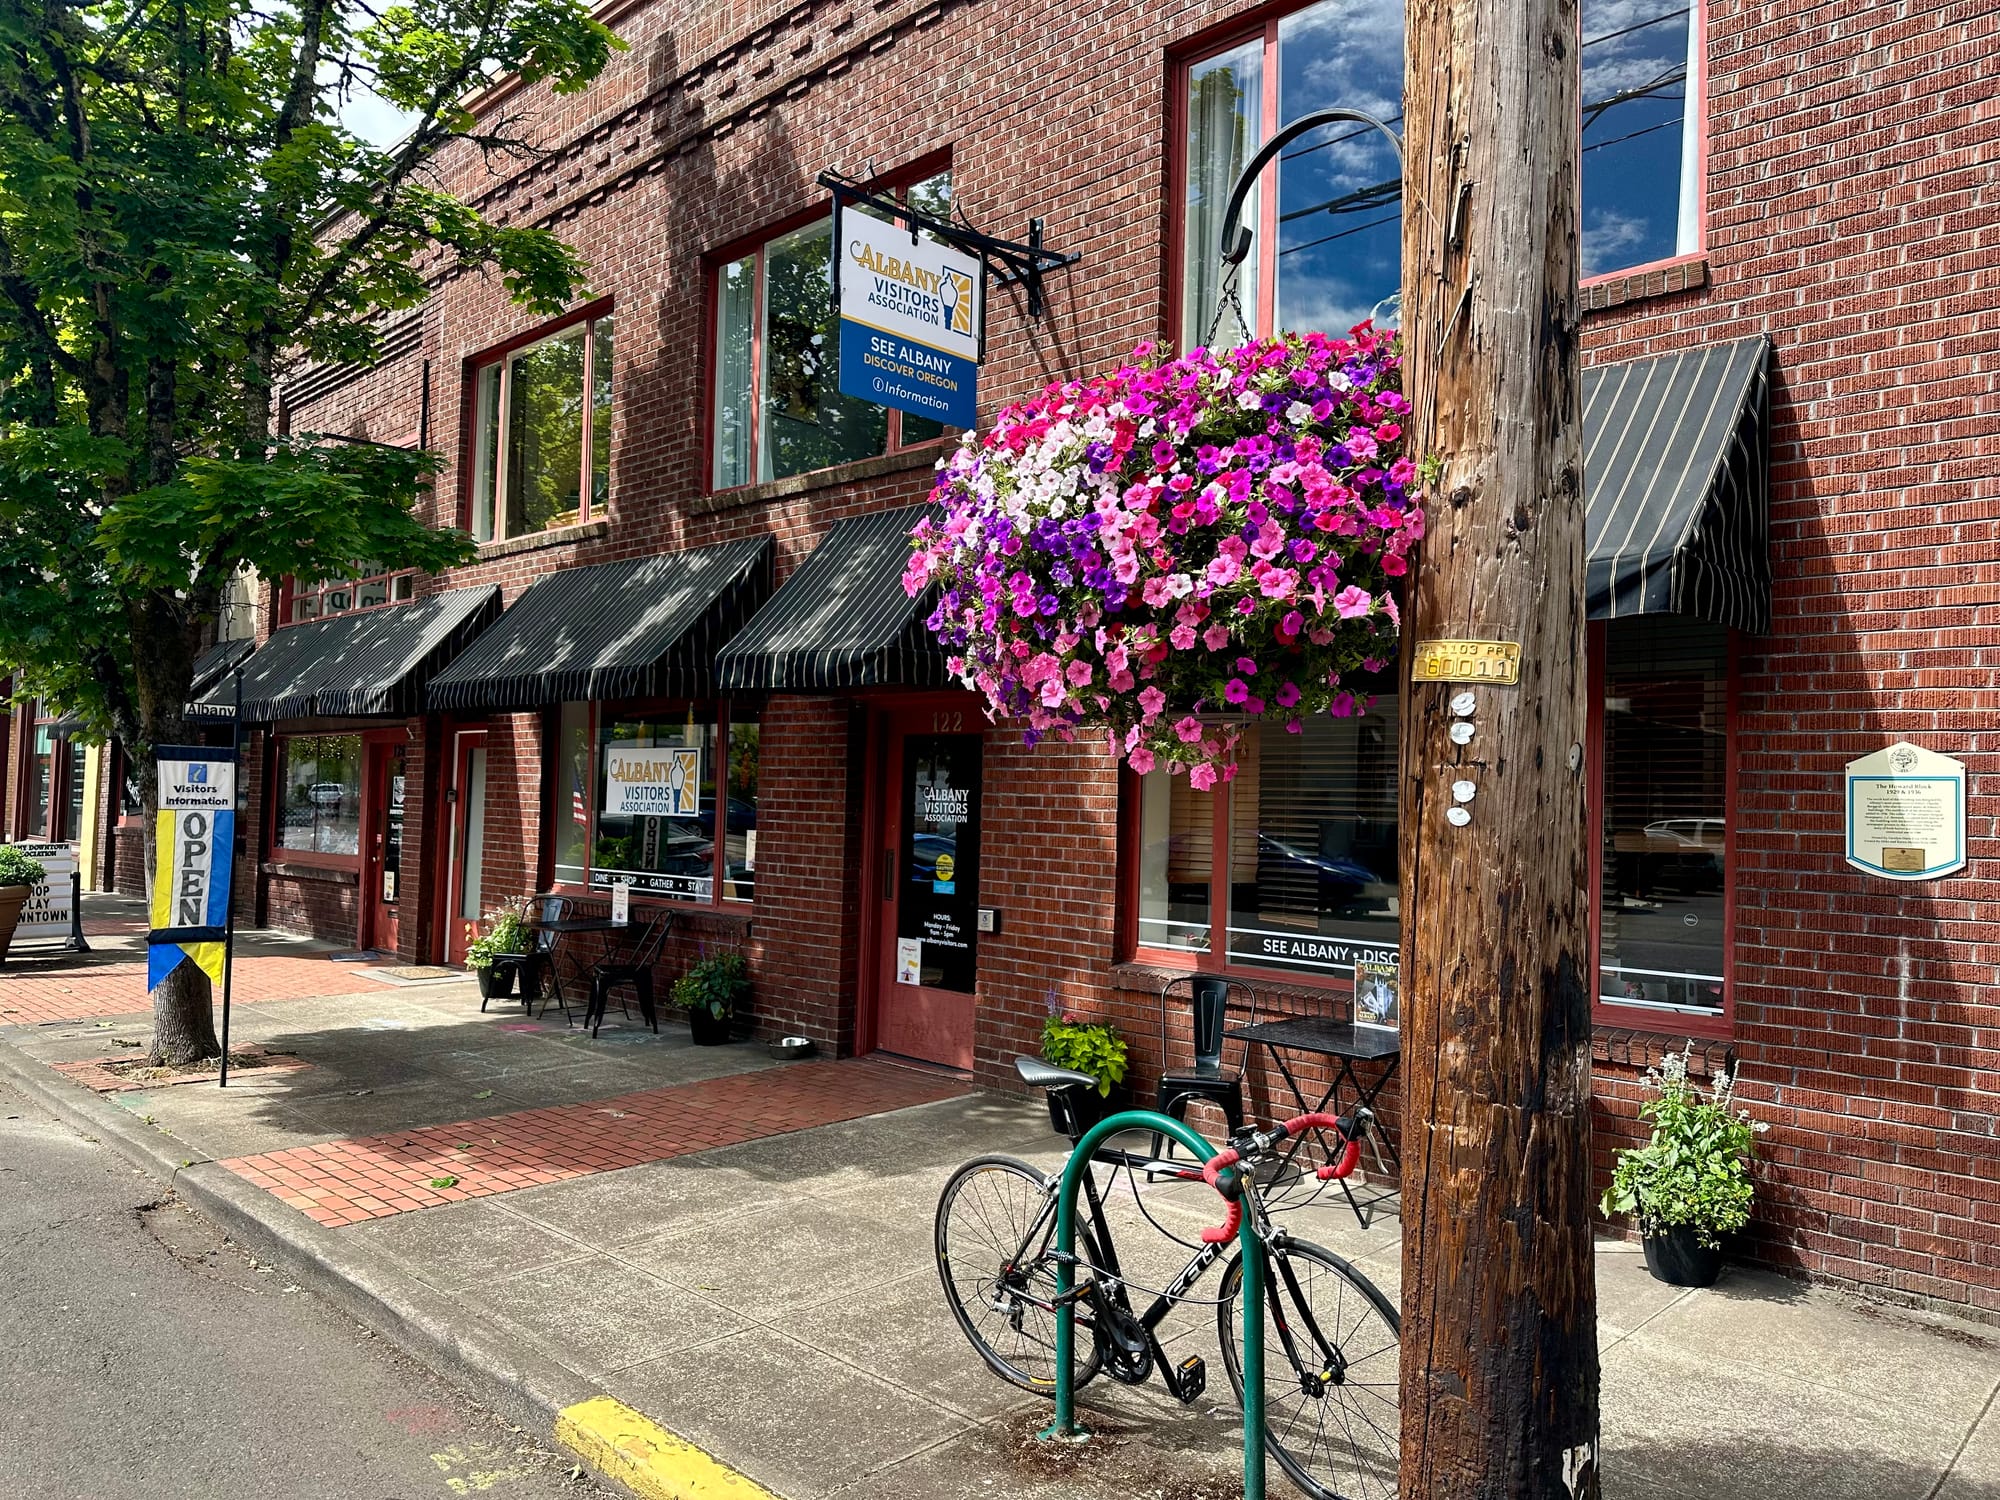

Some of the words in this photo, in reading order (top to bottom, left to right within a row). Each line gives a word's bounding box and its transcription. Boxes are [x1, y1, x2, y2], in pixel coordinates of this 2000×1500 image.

[850, 240, 943, 294] ALBANY
[874, 277, 939, 313] VISITORS
[868, 293, 939, 326] ASSOCIATION
[870, 336, 895, 356] SEE
[899, 346, 952, 374] ALBANY
[863, 353, 914, 379] DISCOVER
[916, 369, 958, 391] OREGON
[885, 381, 949, 411] Information
[1441, 645, 1478, 655] 1103
[186, 703, 236, 717] Albany
[932, 711, 962, 733] 122
[610, 758, 673, 783] ALBANY
[173, 785, 217, 793] Visitors
[624, 786, 670, 800] VISITORS
[924, 787, 969, 802] ALBANY
[166, 796, 228, 806] Information
[620, 801, 670, 813] ASSOCIATION
[924, 802, 968, 815] VISITORS
[924, 814, 968, 823] ASSOCIATION
[177, 812, 207, 926] OPEN
[595, 873, 608, 883] DINE
[621, 874, 637, 886] SHOP
[650, 878, 674, 889] GATHER
[687, 881, 704, 892] STAY
[21, 899, 50, 909] PLAY
[946, 924, 960, 933] Friday
[1263, 939, 1288, 954] SEE
[1291, 941, 1349, 961] ALBANY
[1363, 949, 1399, 964] DISC
